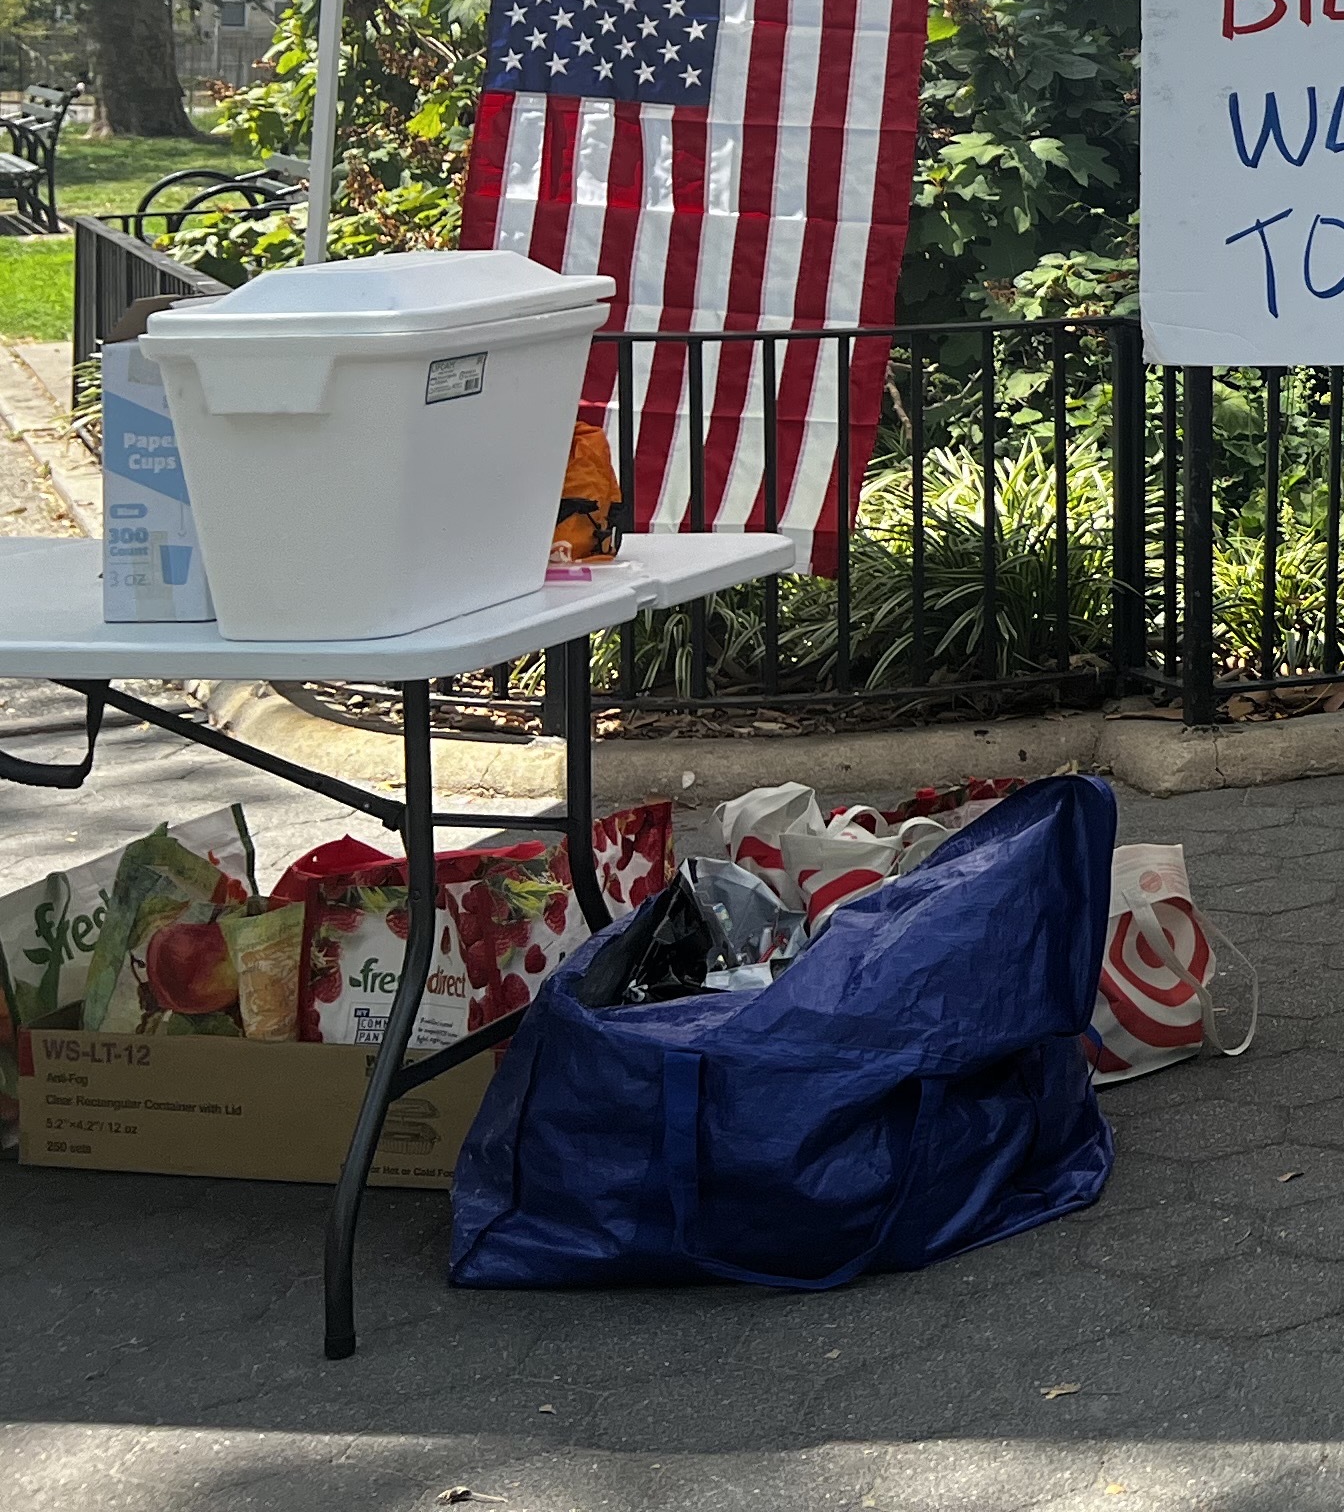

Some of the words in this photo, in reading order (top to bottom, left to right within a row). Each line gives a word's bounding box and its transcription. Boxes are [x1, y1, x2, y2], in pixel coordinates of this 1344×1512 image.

[128, 454, 177, 473] Cups
[109, 528, 149, 544] 300
[109, 546, 148, 557] Count
[43, 1039, 151, 1066] WS-LT-12
[76, 1096, 142, 1111] Rectangular
[145, 1099, 196, 1113] Container
[225, 1105, 242, 1116] Lid
